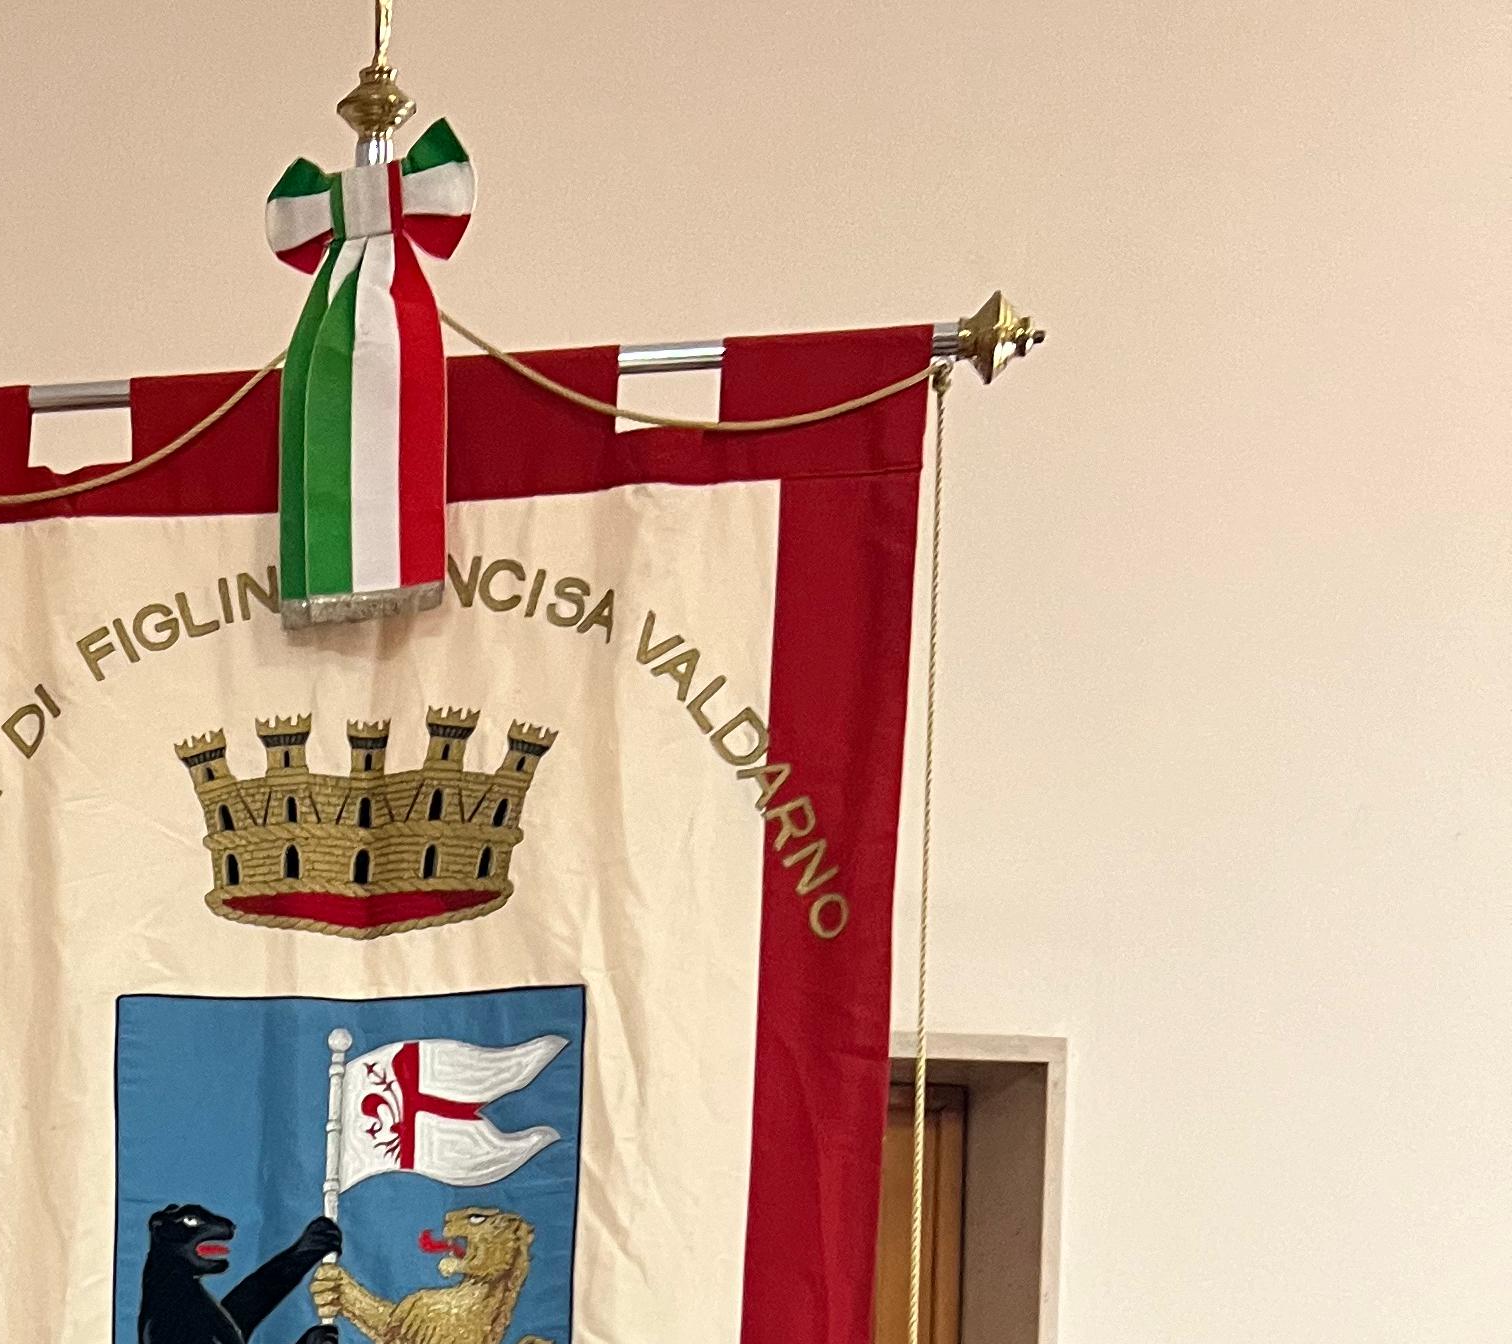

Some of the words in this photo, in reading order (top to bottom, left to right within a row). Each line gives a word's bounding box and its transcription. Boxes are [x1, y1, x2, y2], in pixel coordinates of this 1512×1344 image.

[1, 684, 62, 760] DI
[76, 565, 281, 682] FIGLIN
[447, 554, 615, 644] NCISA
[636, 610, 850, 939] VALDARNO
